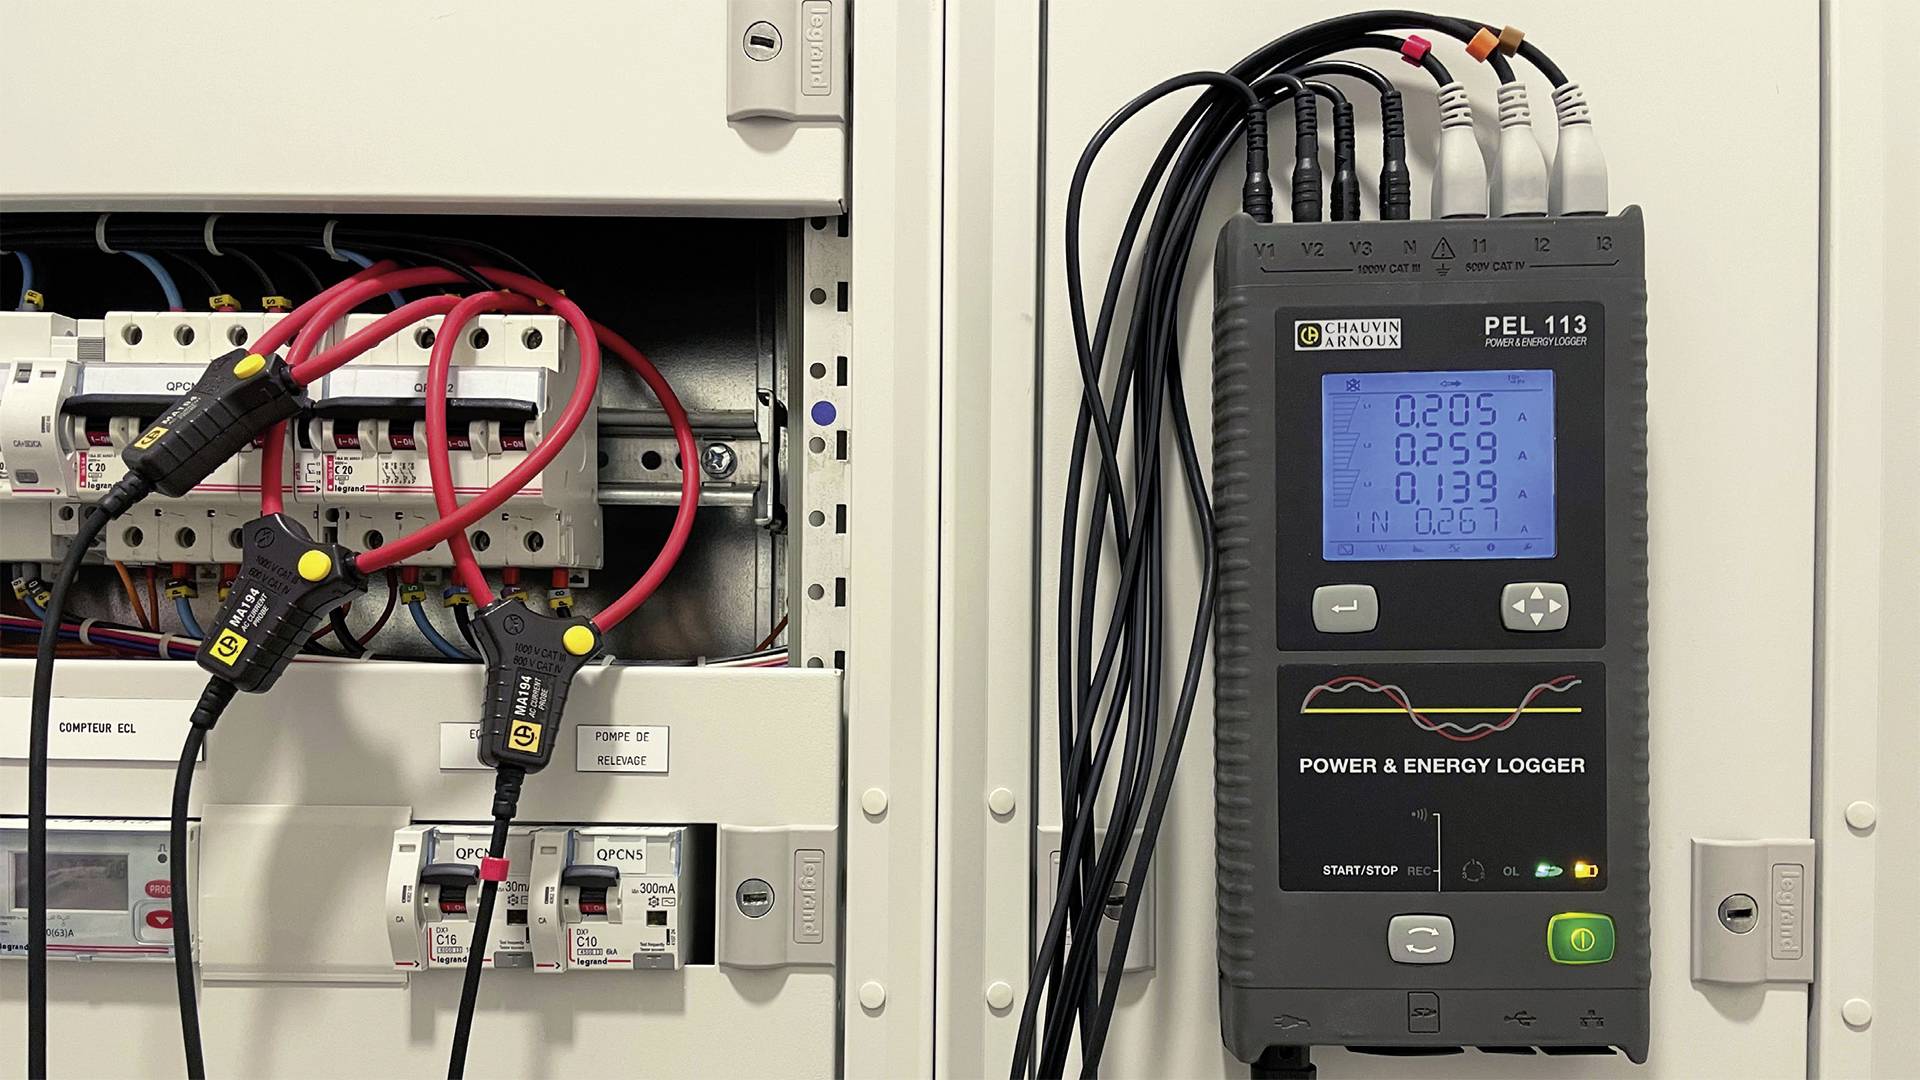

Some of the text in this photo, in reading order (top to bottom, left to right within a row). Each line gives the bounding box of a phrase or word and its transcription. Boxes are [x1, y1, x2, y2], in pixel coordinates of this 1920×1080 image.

[806, 8, 828, 89] legrand
[1254, 242, 1275, 257] V1
[1301, 242, 1324, 257] V2
[1349, 241, 1373, 256] V3
[1403, 240, 1417, 254] N
[1389, 263, 1409, 273] CAT
[1411, 263, 1421, 272] III
[1492, 261, 1512, 271] CAT
[1514, 261, 1526, 270] IV
[1325, 321, 1400, 334] CHAUVIN
[1484, 315, 1587, 335] PEL 113
[1325, 334, 1398, 347] ARNOUX
[1485, 338, 1514, 347] POWER
[1521, 337, 1554, 347] ENERGY
[1553, 336, 1587, 346] LOGGER
[1394, 393, 1527, 429] 0.205 A
[1394, 431, 1527, 468] 0.259 A
[88, 463, 106, 472] C 20
[335, 466, 353, 474] C 20
[88, 482, 113, 491] legran
[334, 485, 365, 493] legrand
[1394, 470, 1527, 506] 0.139 A
[1415, 507, 1499, 535] 0.267
[1520, 525, 1528, 533] A
[229, 587, 261, 627] MA194
[247, 593, 269, 623] CURRENT
[252, 604, 270, 627] PROBE
[541, 646, 559, 660] CAT
[536, 660, 556, 671] CAT
[514, 675, 533, 716] MA194
[530, 677, 542, 708] CURRENT
[538, 688, 549, 711] PROBE
[59, 722, 136, 733] COMPTEUR ECL
[595, 731, 650, 742] POMPE DE
[597, 755, 647, 766] RELEVAGE
[1300, 757, 1585, 774] POWER & ENERGY LOGGER
[597, 849, 643, 861] QPCN5
[1323, 865, 1432, 876] START/STOP REC
[1503, 866, 1520, 876] OL
[640, 883, 675, 894] 300mA
[799, 857, 821, 936] legrand
[1776, 871, 1800, 952] legrand
[436, 935, 457, 945] C16
[576, 936, 598, 947] C10
[437, 955, 467, 964] legrand
[577, 958, 607, 966] legrand
